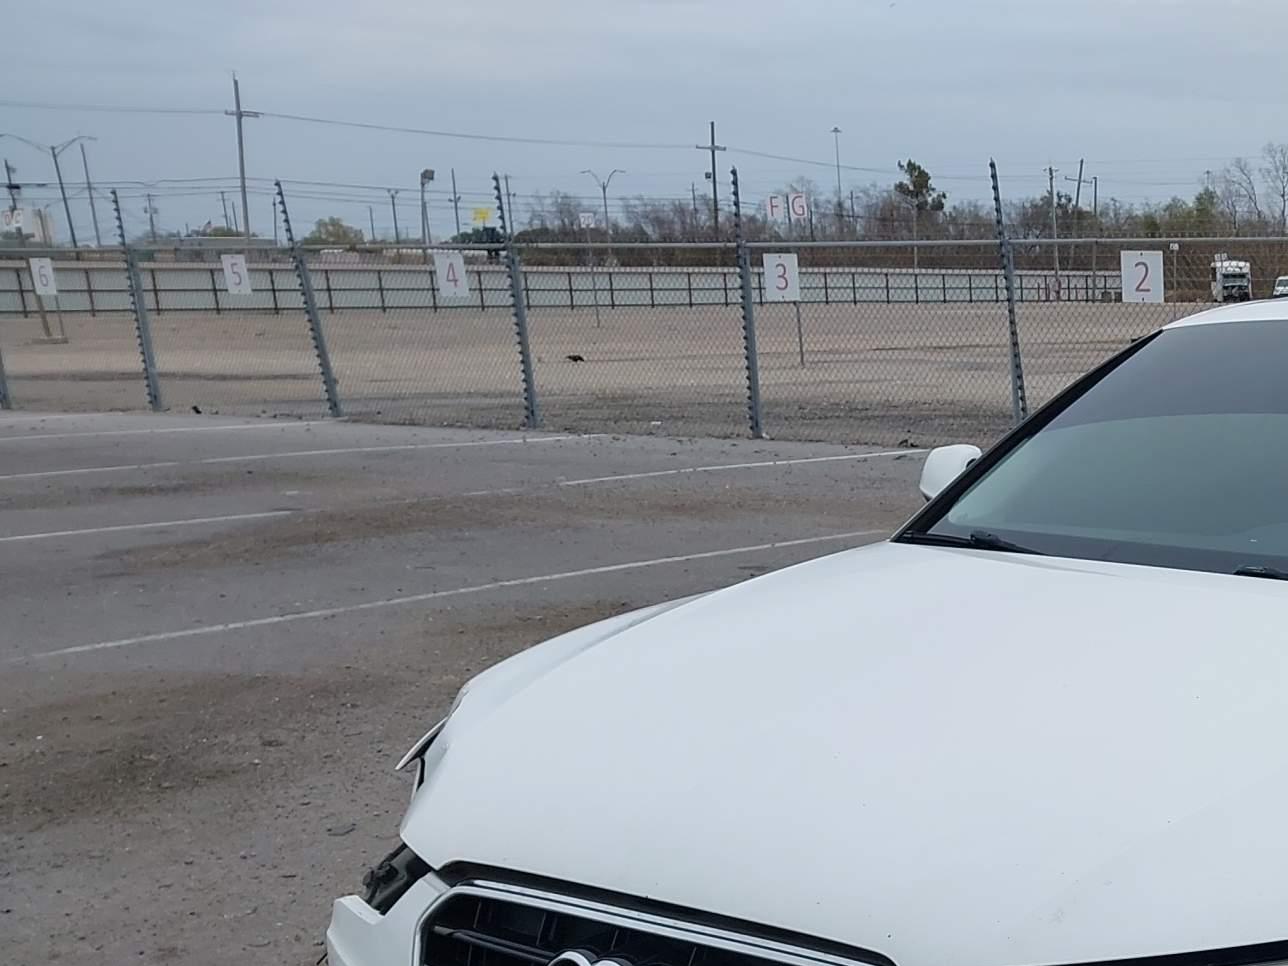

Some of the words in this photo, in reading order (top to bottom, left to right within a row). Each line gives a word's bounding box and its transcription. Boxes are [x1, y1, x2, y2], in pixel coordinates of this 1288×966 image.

[770, 196, 779, 216] F
[791, 195, 805, 217] G
[38, 264, 49, 287] 6
[231, 262, 242, 285] 5
[446, 263, 459, 287] 4
[775, 263, 788, 291] 3
[1135, 262, 1151, 292] 2
